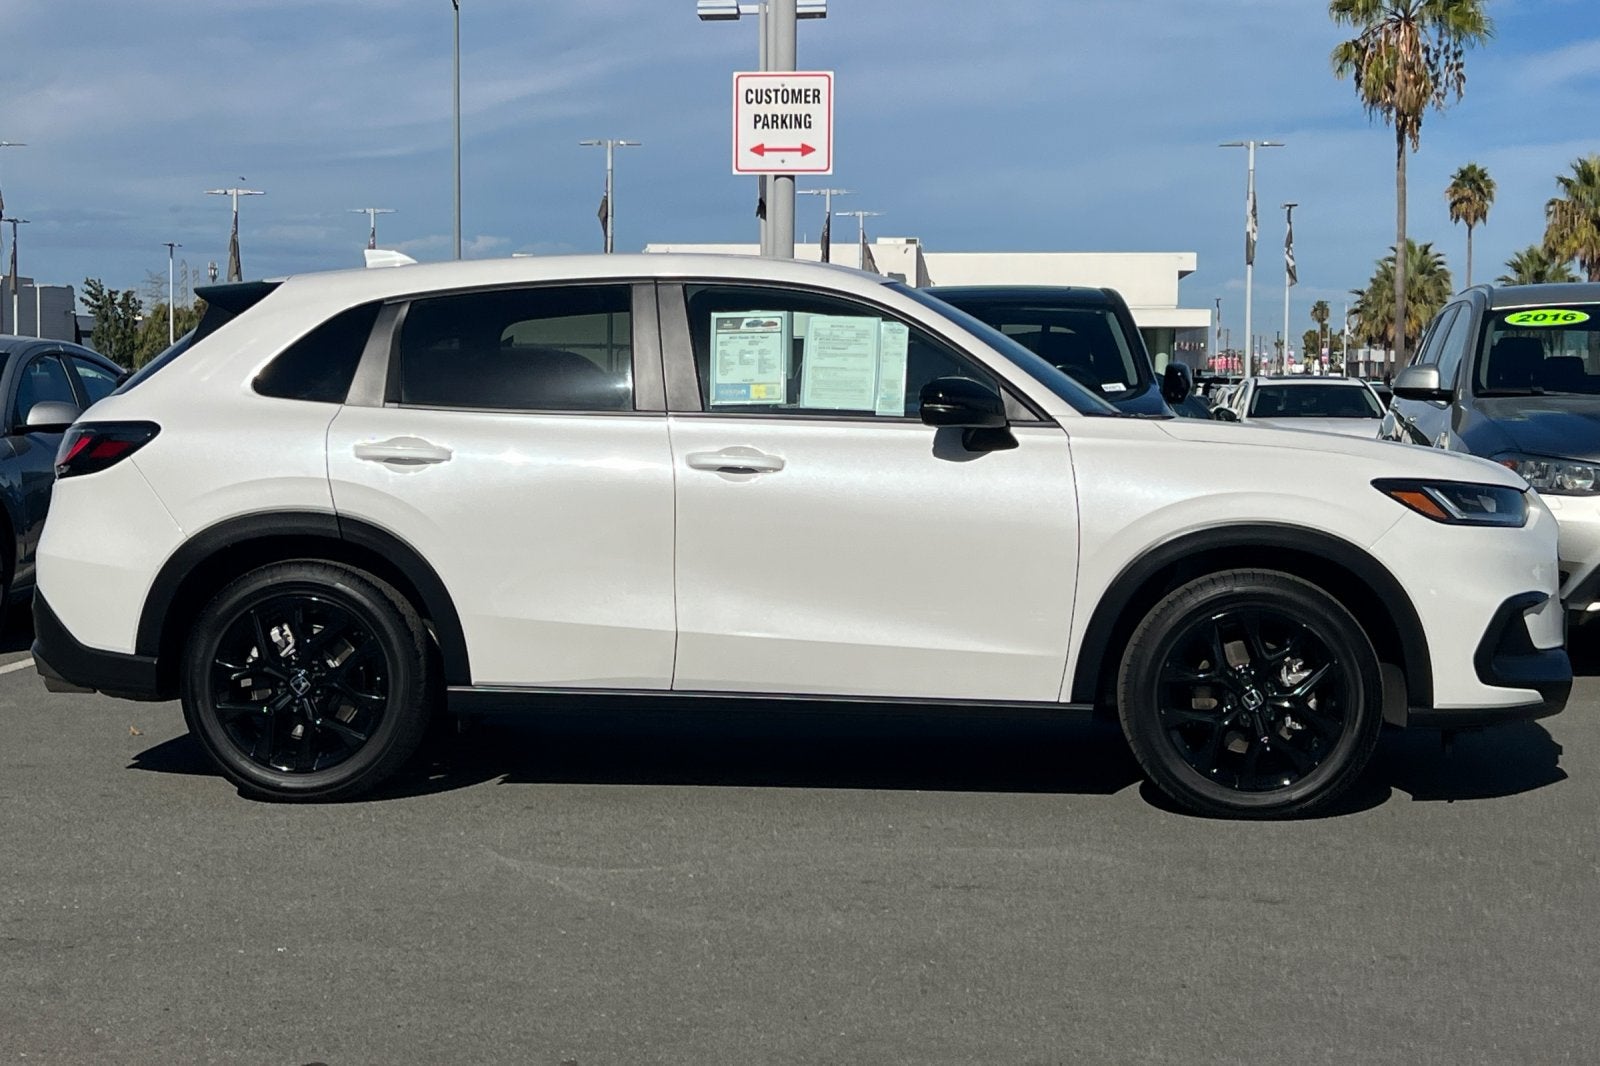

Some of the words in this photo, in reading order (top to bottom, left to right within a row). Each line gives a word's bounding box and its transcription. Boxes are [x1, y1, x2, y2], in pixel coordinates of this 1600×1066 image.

[745, 88, 821, 105] CUSTOMER
[753, 113, 812, 130] PARKING
[1515, 313, 1577, 323] 2016
